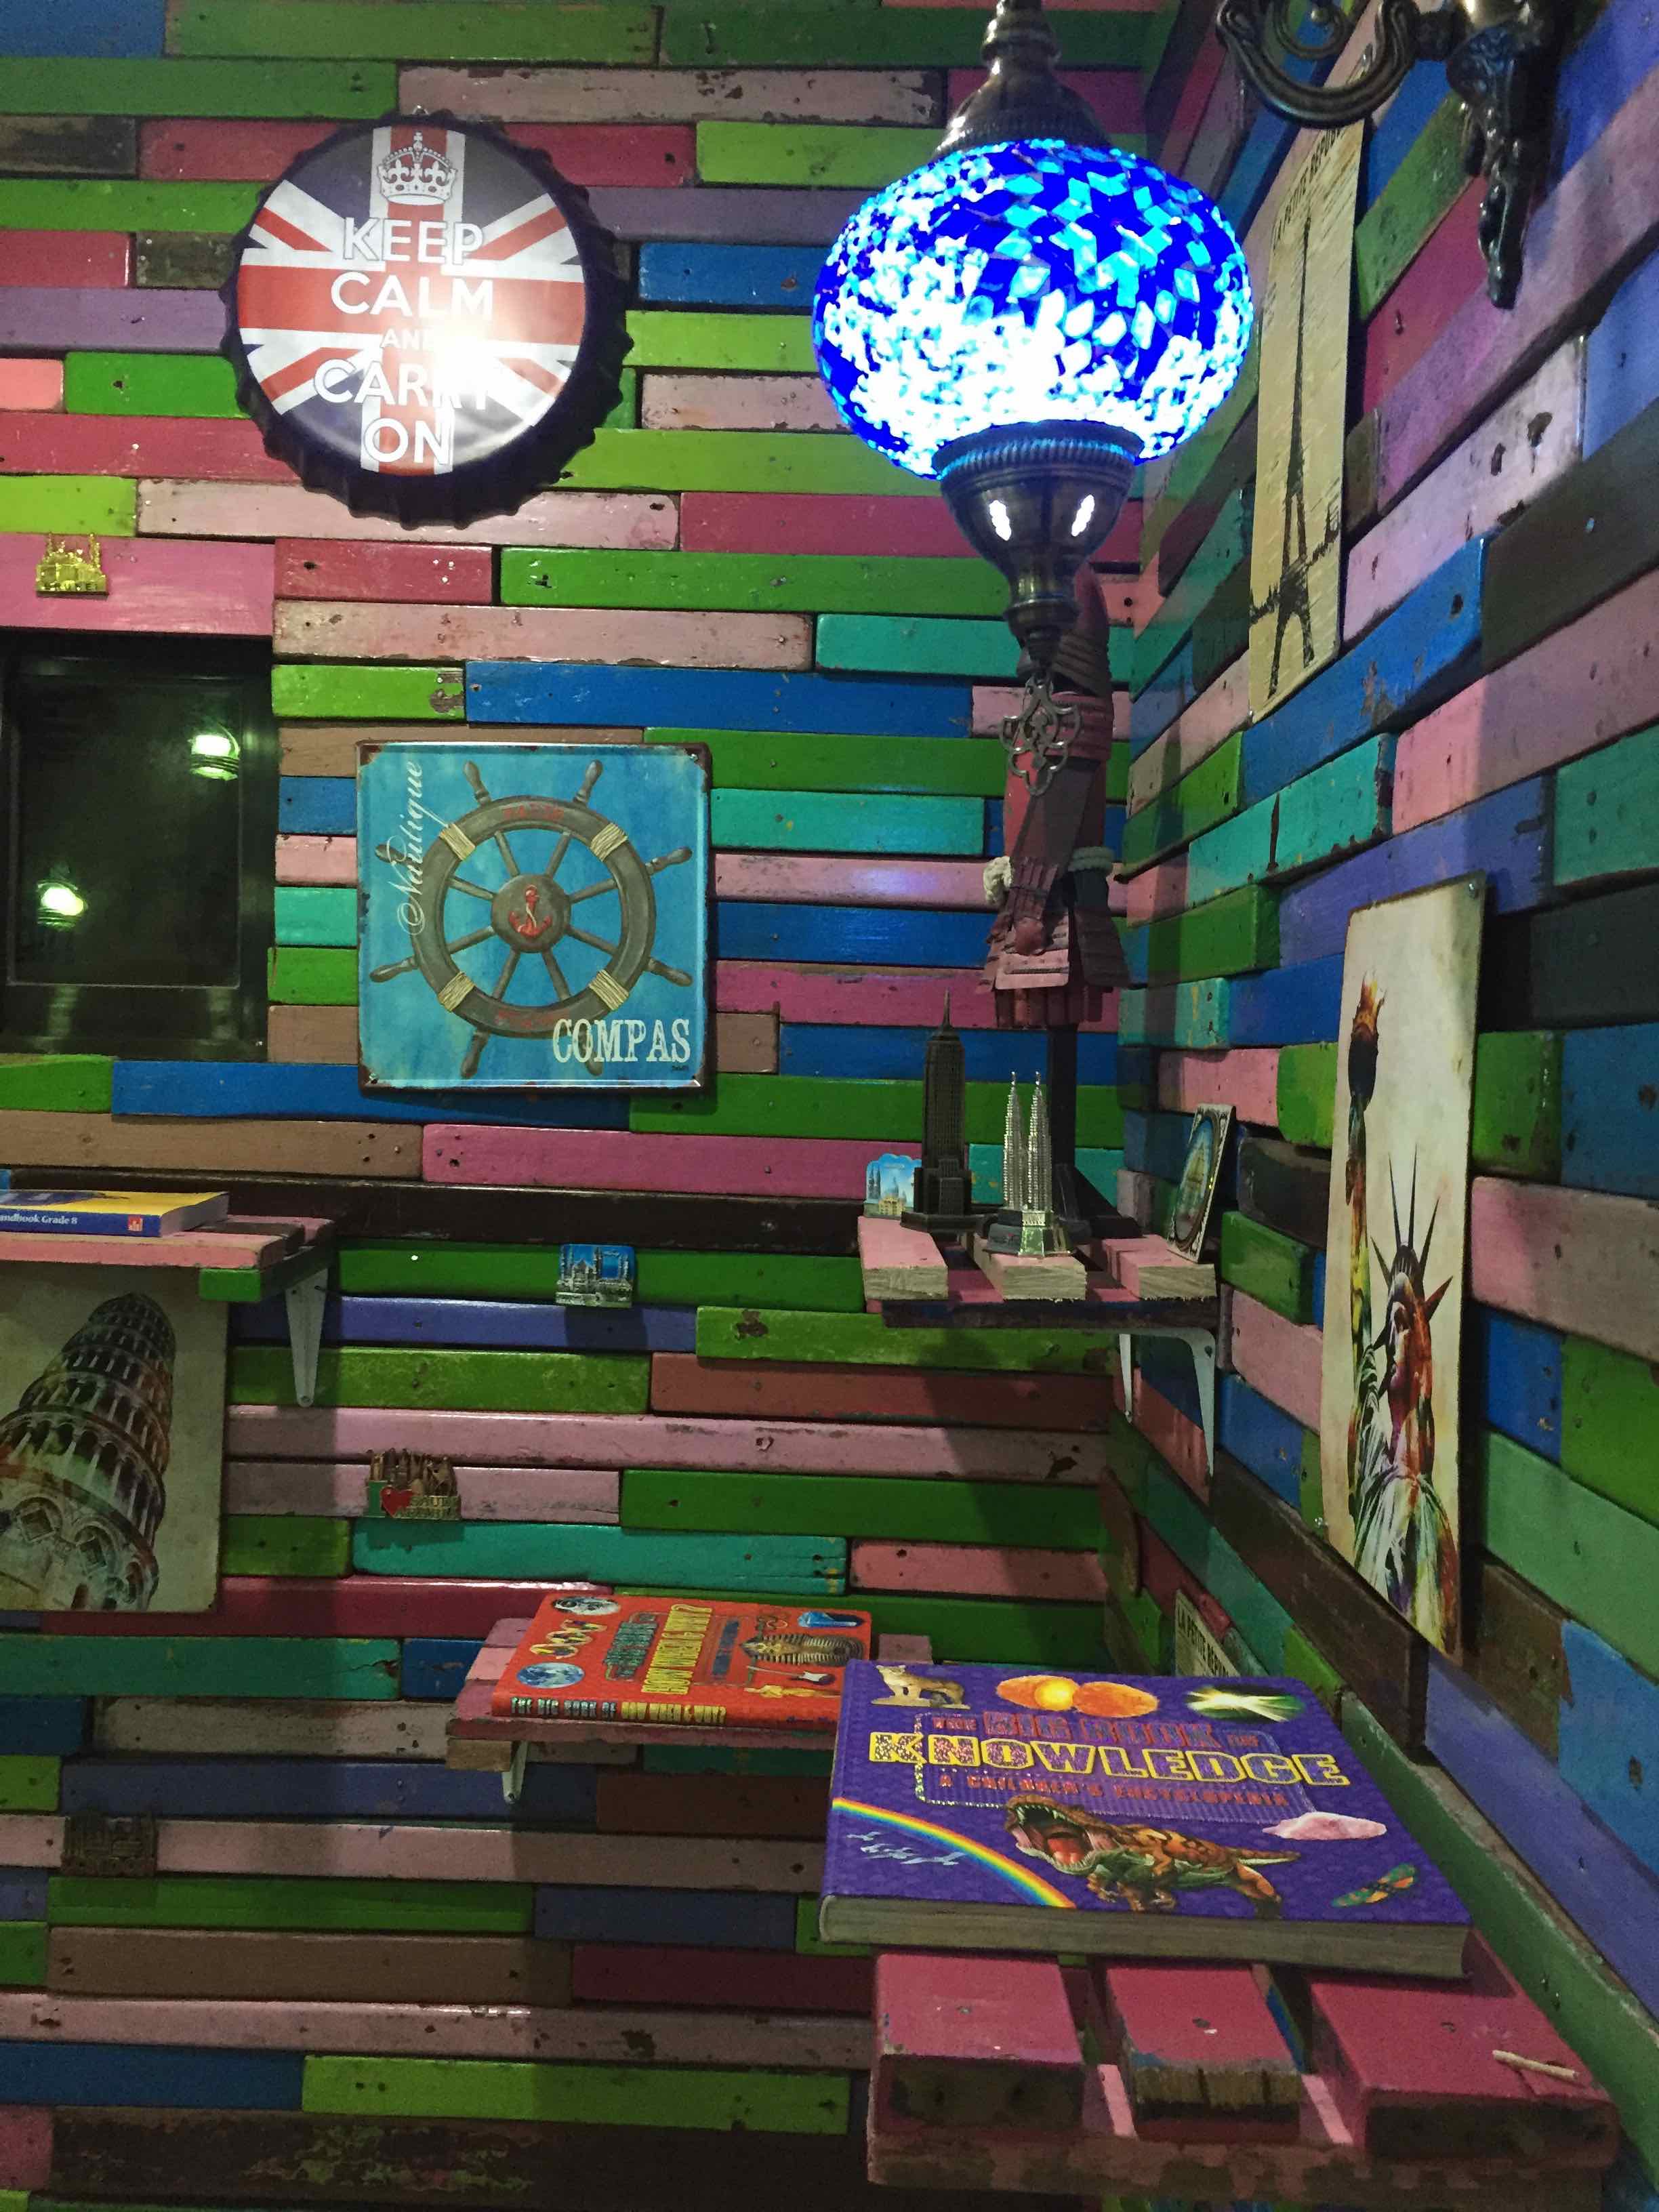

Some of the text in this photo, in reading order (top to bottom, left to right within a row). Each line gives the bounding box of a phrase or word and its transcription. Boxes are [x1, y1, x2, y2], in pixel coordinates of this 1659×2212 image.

[343, 217, 484, 266] KEEP
[331, 271, 494, 321] CALM
[380, 327, 446, 350] AN
[314, 358, 498, 410] CAR
[363, 417, 452, 466] ON
[387, 760, 449, 935] Nautique
[552, 1019, 691, 1063] COMPAS
[41, 1216, 70, 1225] Grade
[70, 1216, 78, 1225] 8
[640, 1668, 694, 1695] HOW
[983, 1711, 1073, 1742] BIG
[1080, 1717, 1222, 1748] BOOK
[869, 1732, 1351, 1786] KNOWLEDGE
[939, 1774, 954, 1788] A
[1115, 1784, 1286, 1807] ENCYCLOPEDIA
